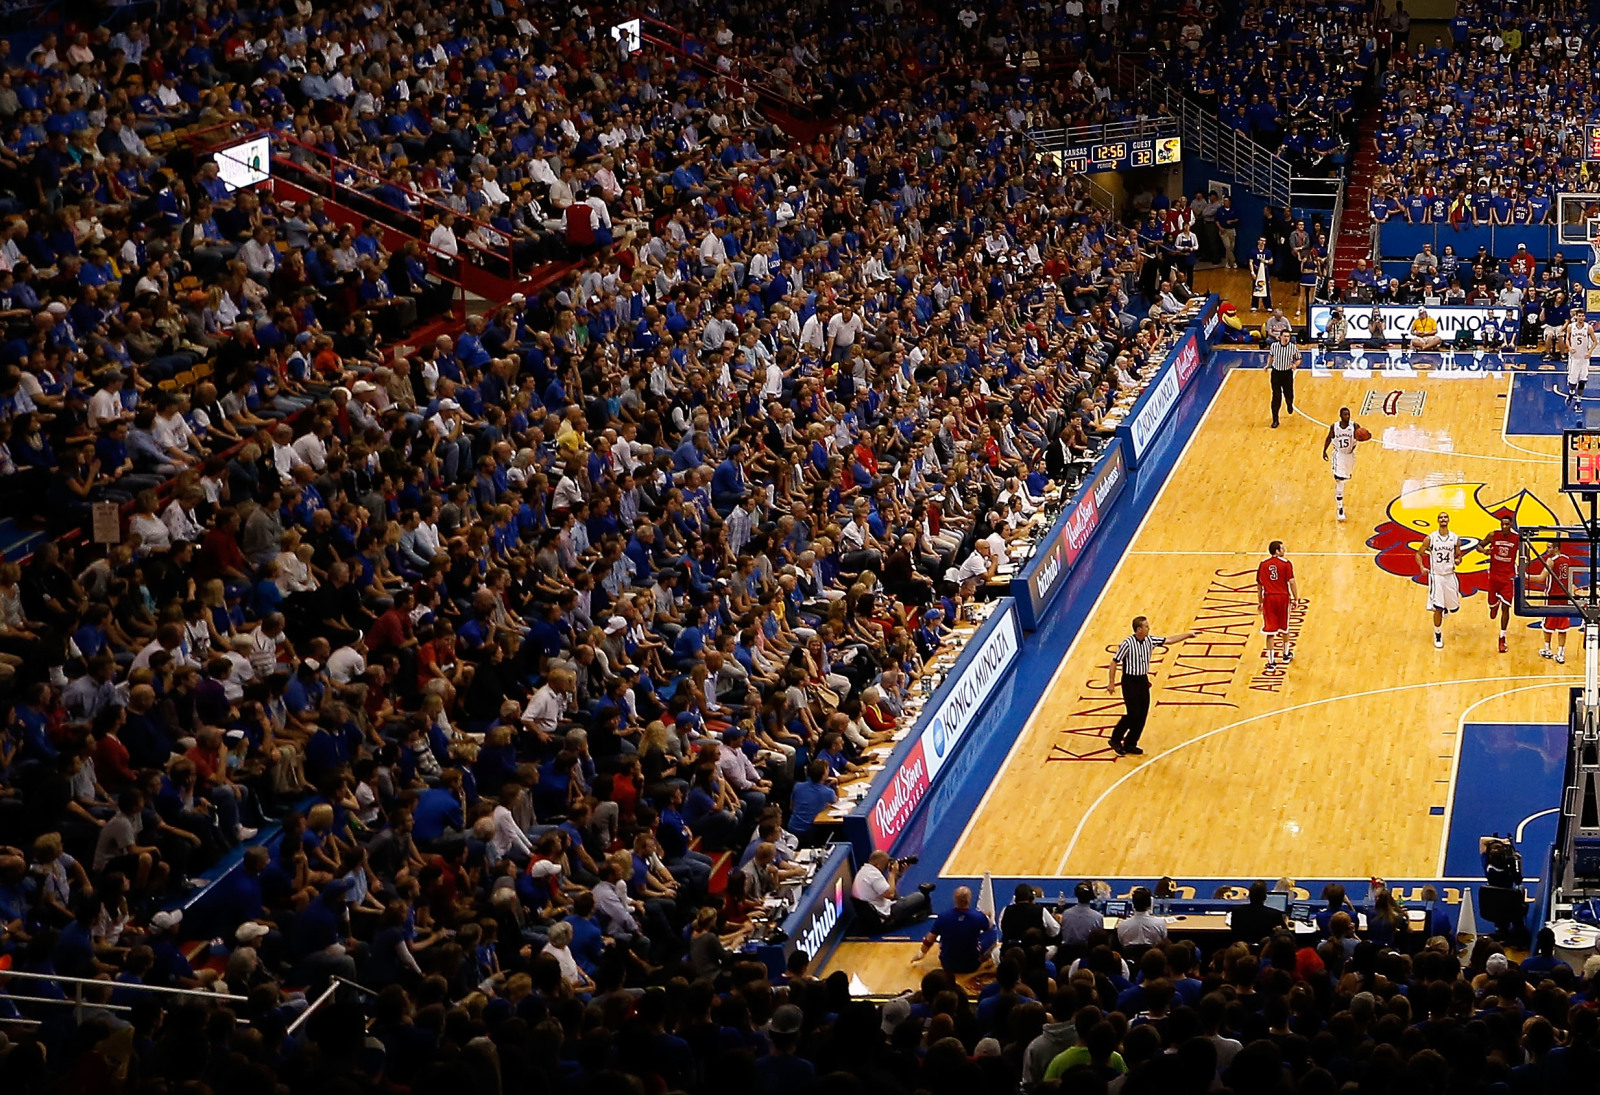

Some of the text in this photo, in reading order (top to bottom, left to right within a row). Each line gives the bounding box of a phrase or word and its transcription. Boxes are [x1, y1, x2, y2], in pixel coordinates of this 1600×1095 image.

[1063, 147, 1088, 157] KANSAS
[1098, 144, 1124, 159] 12:56
[1132, 140, 1152, 150] GUEST
[1111, 159, 1117, 170] 2
[1137, 151, 1151, 164] 32
[1070, 159, 1085, 171] 41
[1576, 337, 1583, 346] 5
[1338, 438, 1350, 449] 15
[1436, 552, 1450, 564] 34
[1036, 550, 1059, 598] bizhub
[1269, 564, 1279, 581] 3
[1155, 568, 1262, 709] JAYHAWKS
[943, 629, 1010, 742] KONICA MINOLTA
[876, 774, 902, 839] Russell
[895, 783, 925, 833] CANDIES
[796, 897, 837, 962] bizhub
